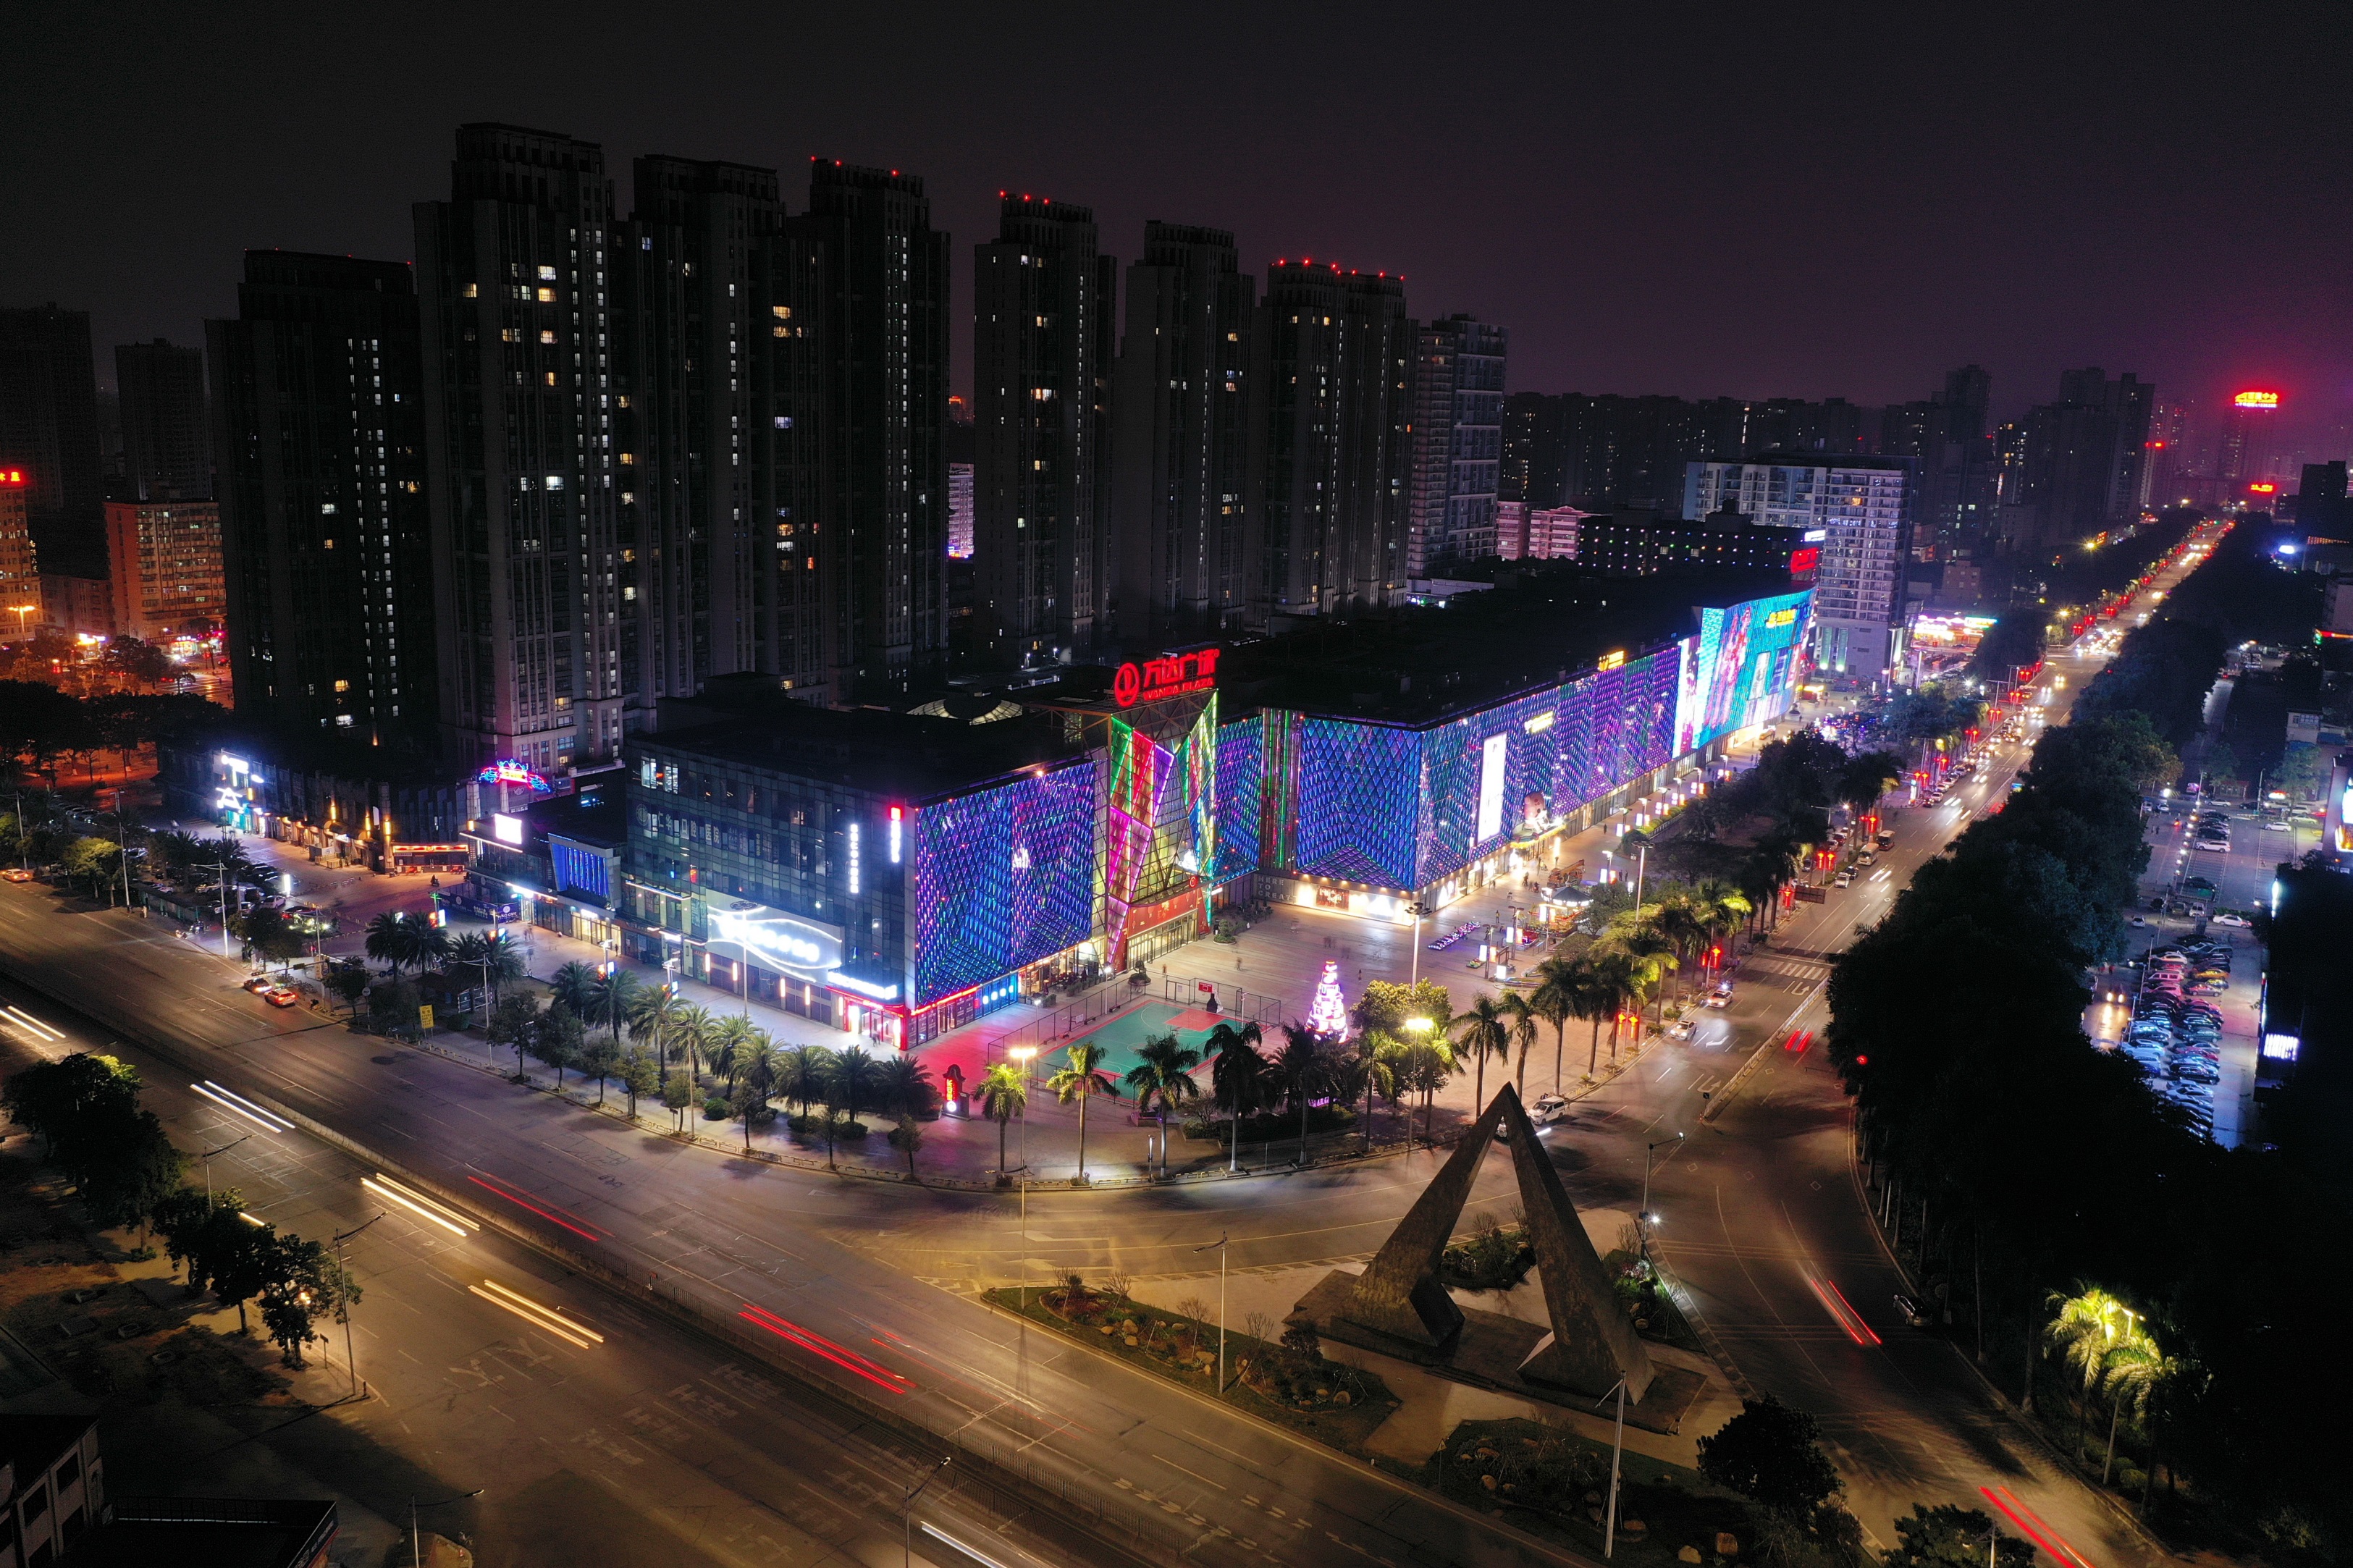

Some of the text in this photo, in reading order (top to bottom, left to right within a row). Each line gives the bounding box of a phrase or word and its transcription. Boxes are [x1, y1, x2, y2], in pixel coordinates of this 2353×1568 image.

[1143, 650, 1216, 687] 万达广场
[1143, 677, 1214, 701] WANDA PLAZA
[1258, 875, 1284, 886] HERE
